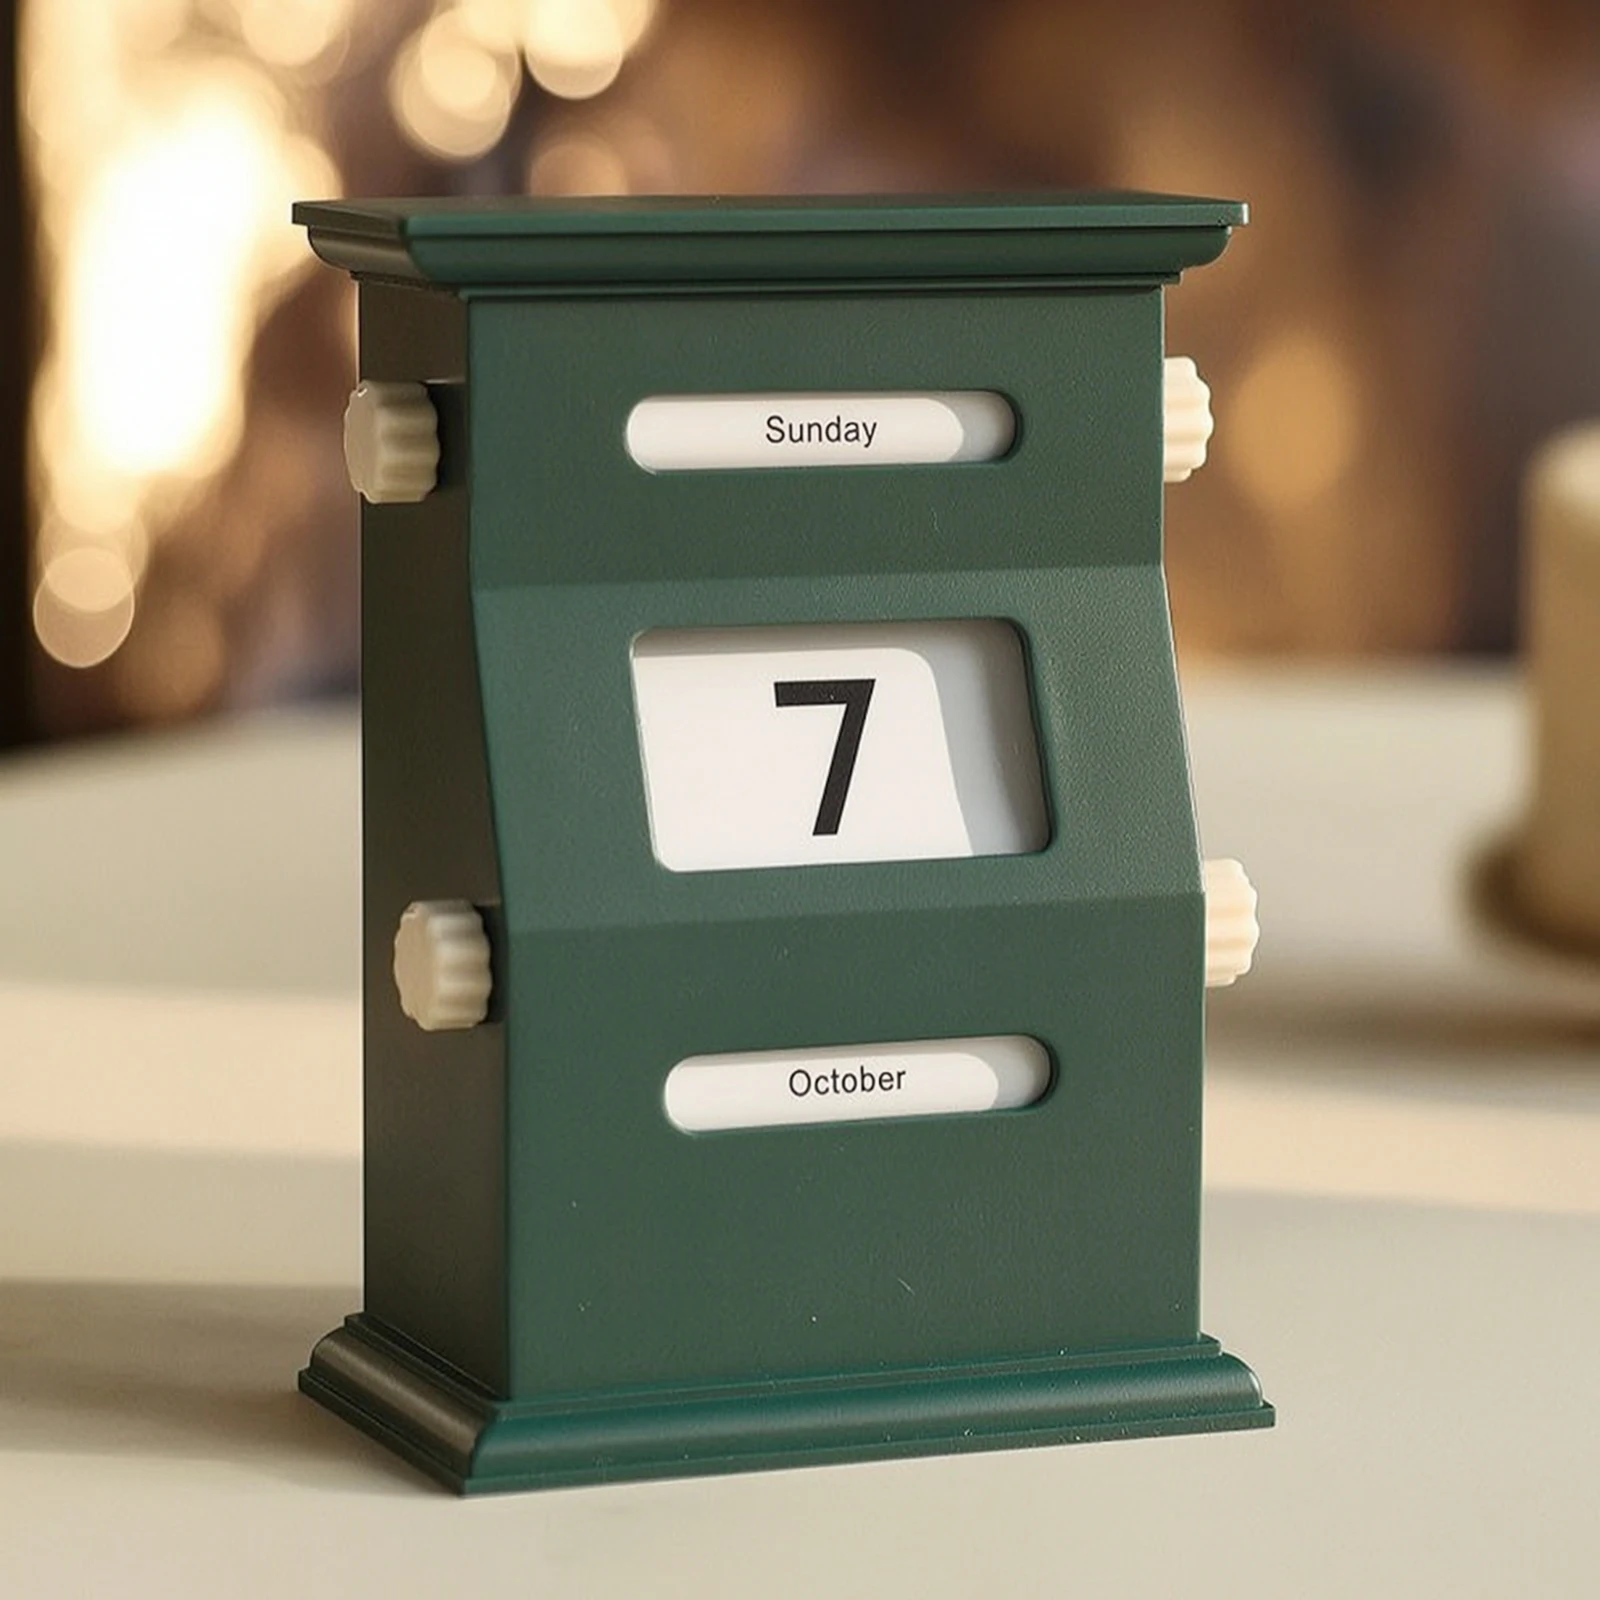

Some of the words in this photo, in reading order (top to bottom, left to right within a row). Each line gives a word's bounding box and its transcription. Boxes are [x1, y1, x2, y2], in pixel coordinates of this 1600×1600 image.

[765, 415, 877, 449] Sunday
[774, 678, 876, 837] 7
[788, 1065, 906, 1097] October
